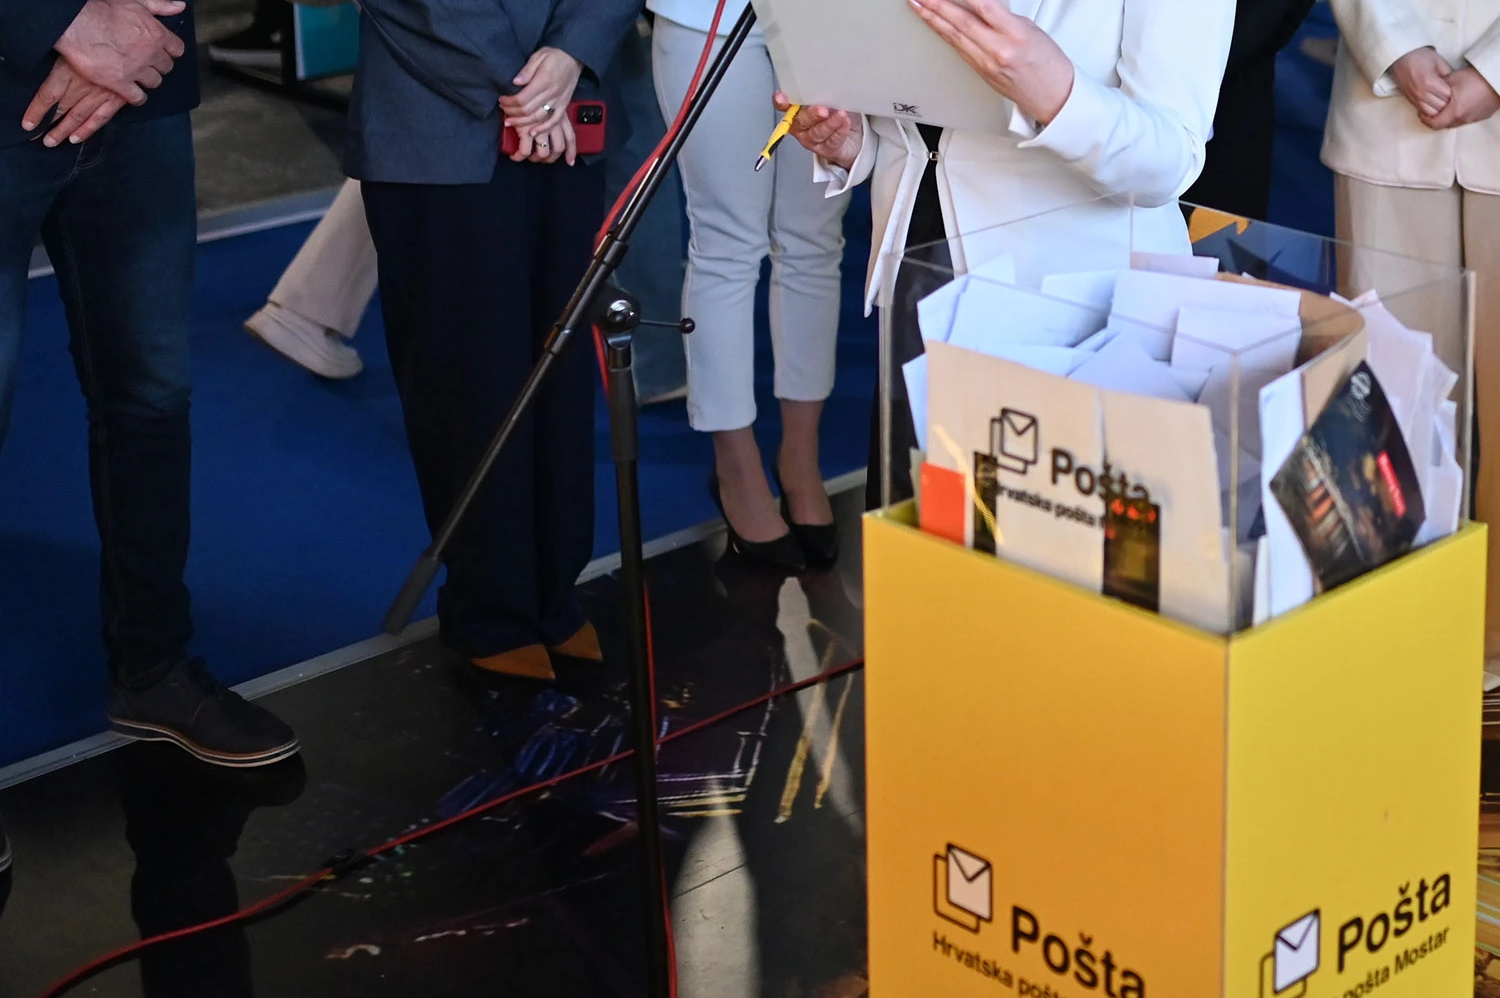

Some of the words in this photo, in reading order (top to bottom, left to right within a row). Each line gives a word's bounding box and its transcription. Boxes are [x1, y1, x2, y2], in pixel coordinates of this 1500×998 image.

[998, 485, 1052, 512] rvatska
[1011, 904, 1145, 998] Pošta
[1337, 872, 1451, 974] Pošta
[1394, 926, 1450, 975] Mostar
[932, 931, 1013, 989] Hrvatska
